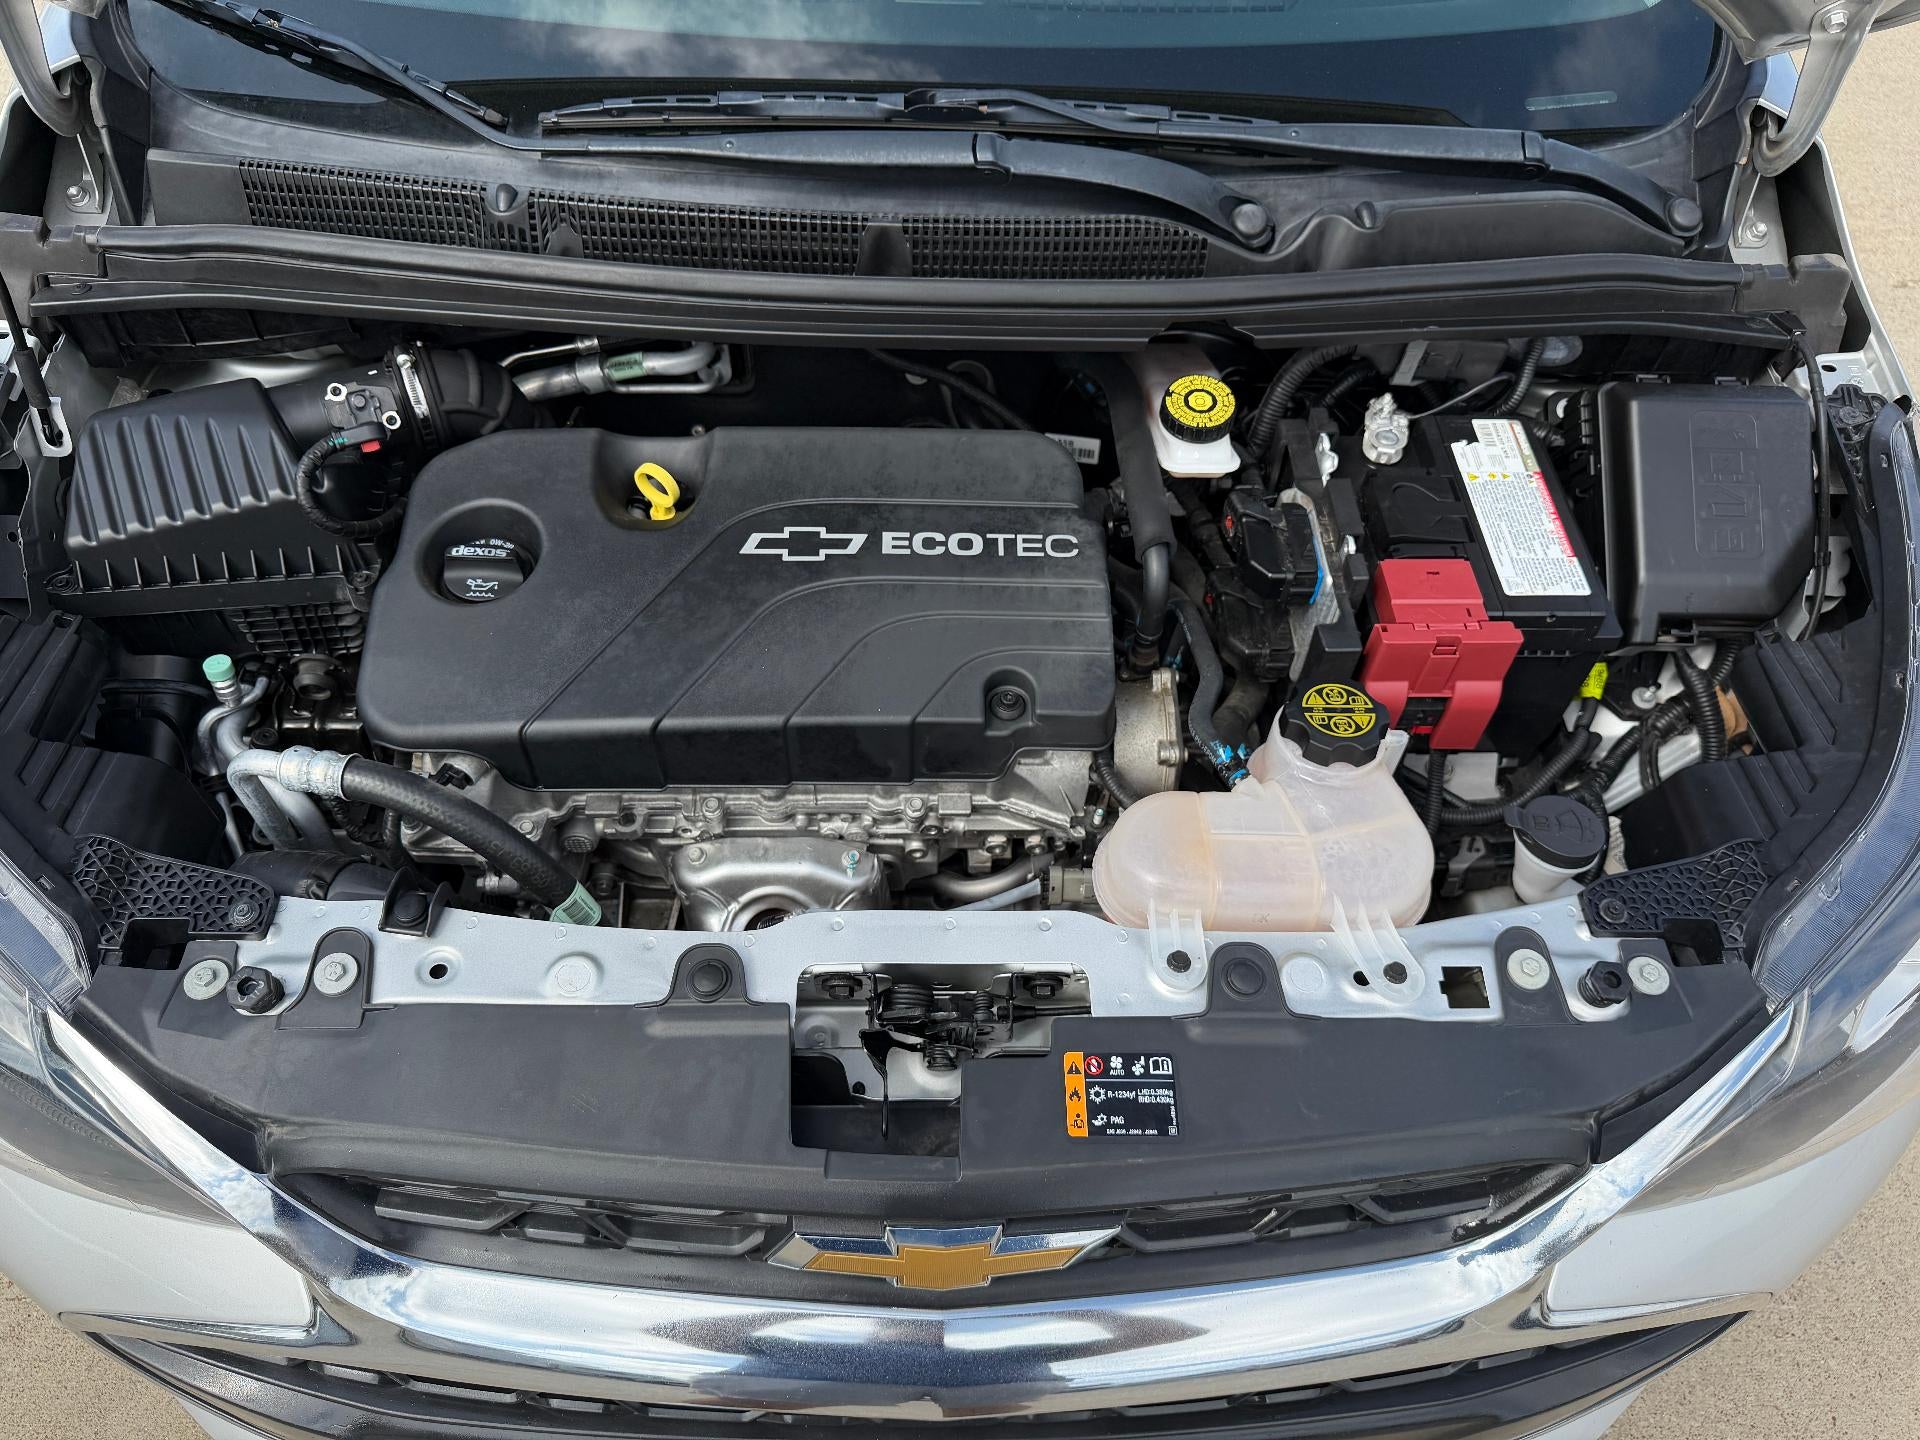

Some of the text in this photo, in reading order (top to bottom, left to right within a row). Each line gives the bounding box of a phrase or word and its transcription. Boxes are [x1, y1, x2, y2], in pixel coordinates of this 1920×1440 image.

[451, 545, 508, 557] dexos
[882, 532, 1079, 558] ECOTEC
[1110, 1116, 1125, 1125] PAG
